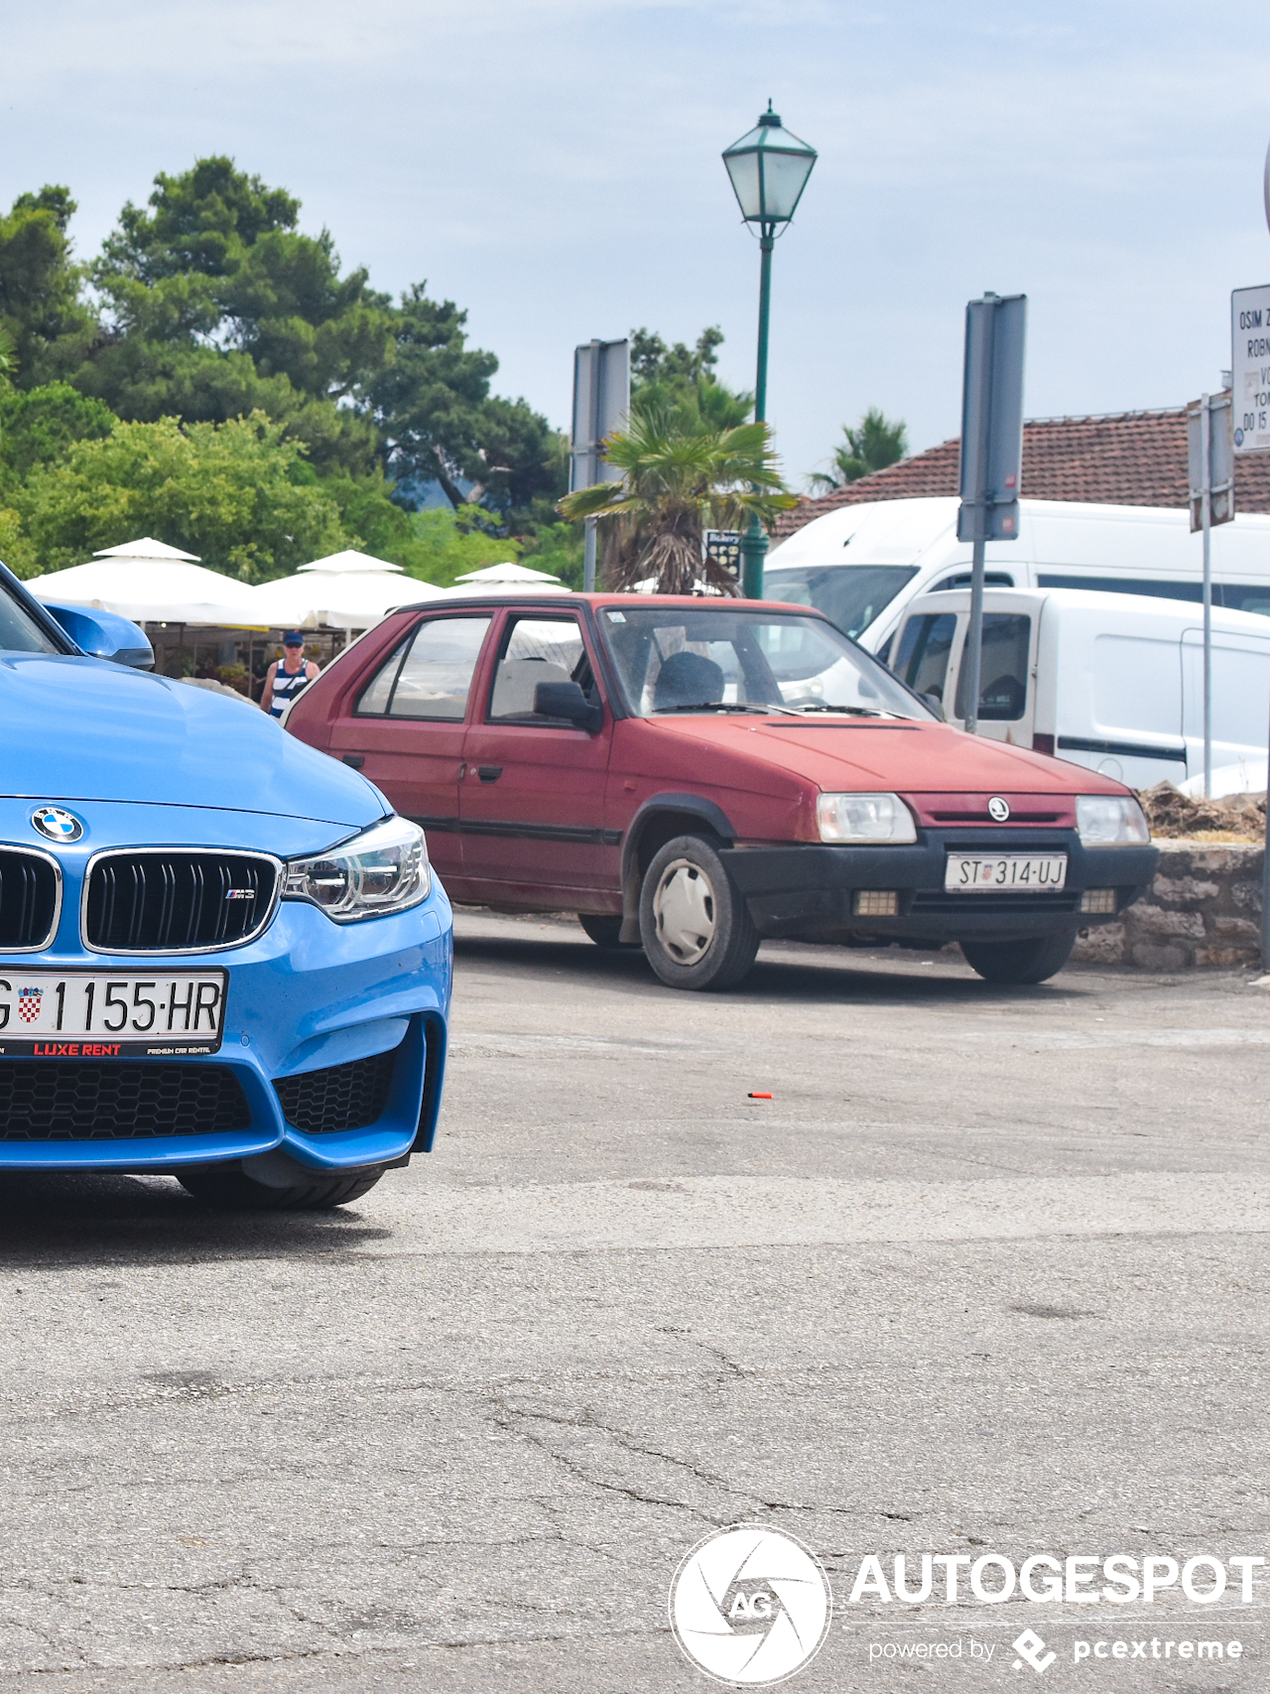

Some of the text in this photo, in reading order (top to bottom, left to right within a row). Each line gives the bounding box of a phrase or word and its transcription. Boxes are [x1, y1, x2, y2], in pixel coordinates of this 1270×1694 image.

[1239, 310, 1262, 330] OSIM
[959, 860, 982, 884] ST
[33, 1043, 121, 1056] LUXE RENT
